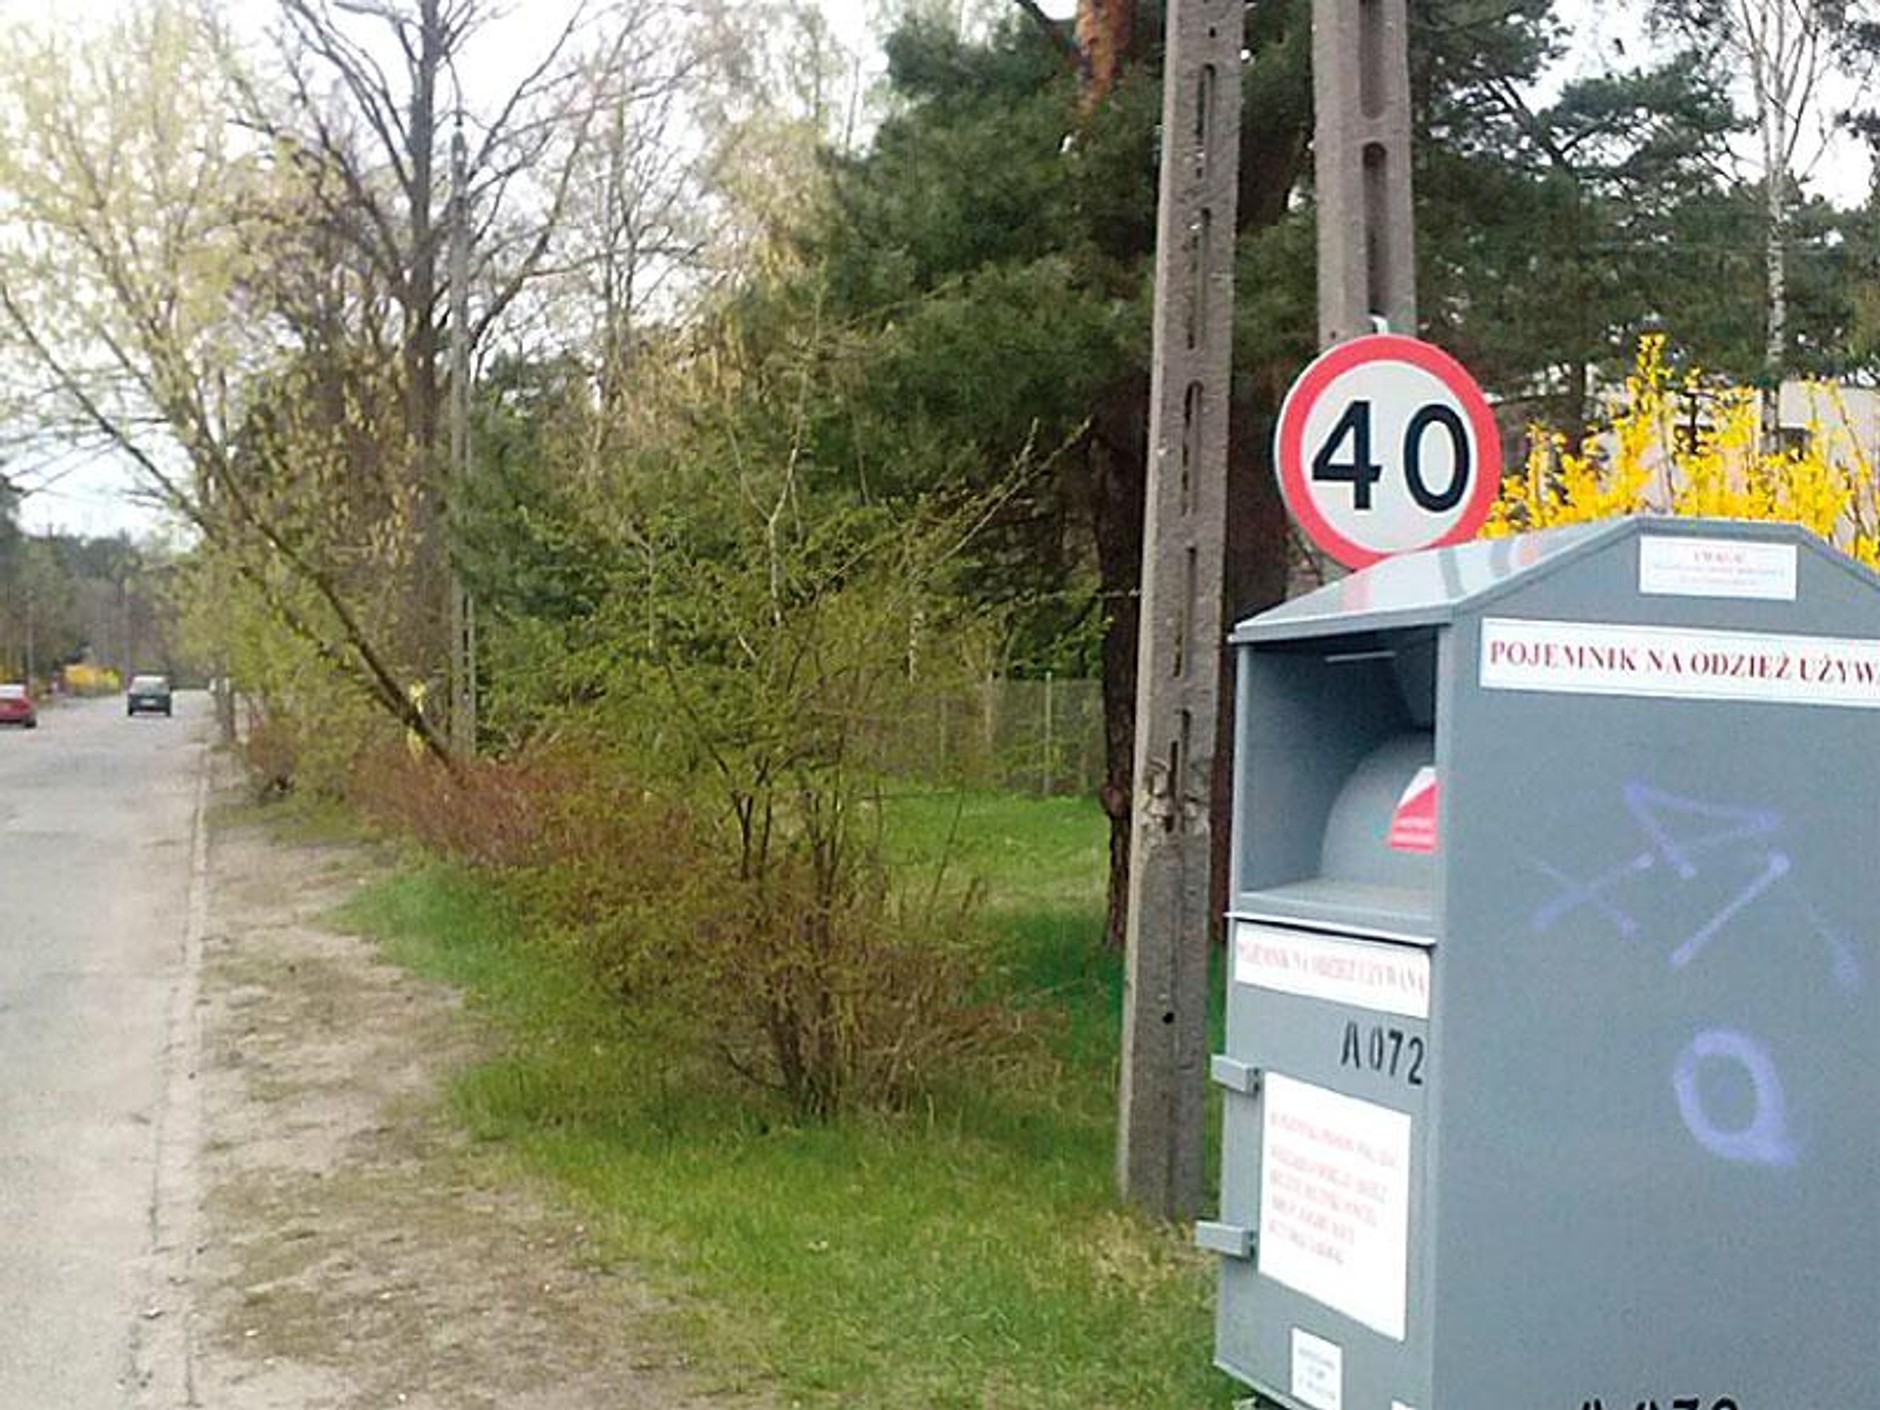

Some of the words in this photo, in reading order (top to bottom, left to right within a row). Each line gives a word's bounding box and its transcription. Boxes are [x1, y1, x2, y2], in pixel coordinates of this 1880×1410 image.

[1312, 400, 1470, 513] 40
[1489, 639, 1638, 672] POJEMNIK
[1647, 648, 1683, 674] NA
[1690, 650, 1792, 679] ODZIEŻ
[1799, 653, 1880, 684] UŻYW
[1340, 1021, 1424, 1086] A072
